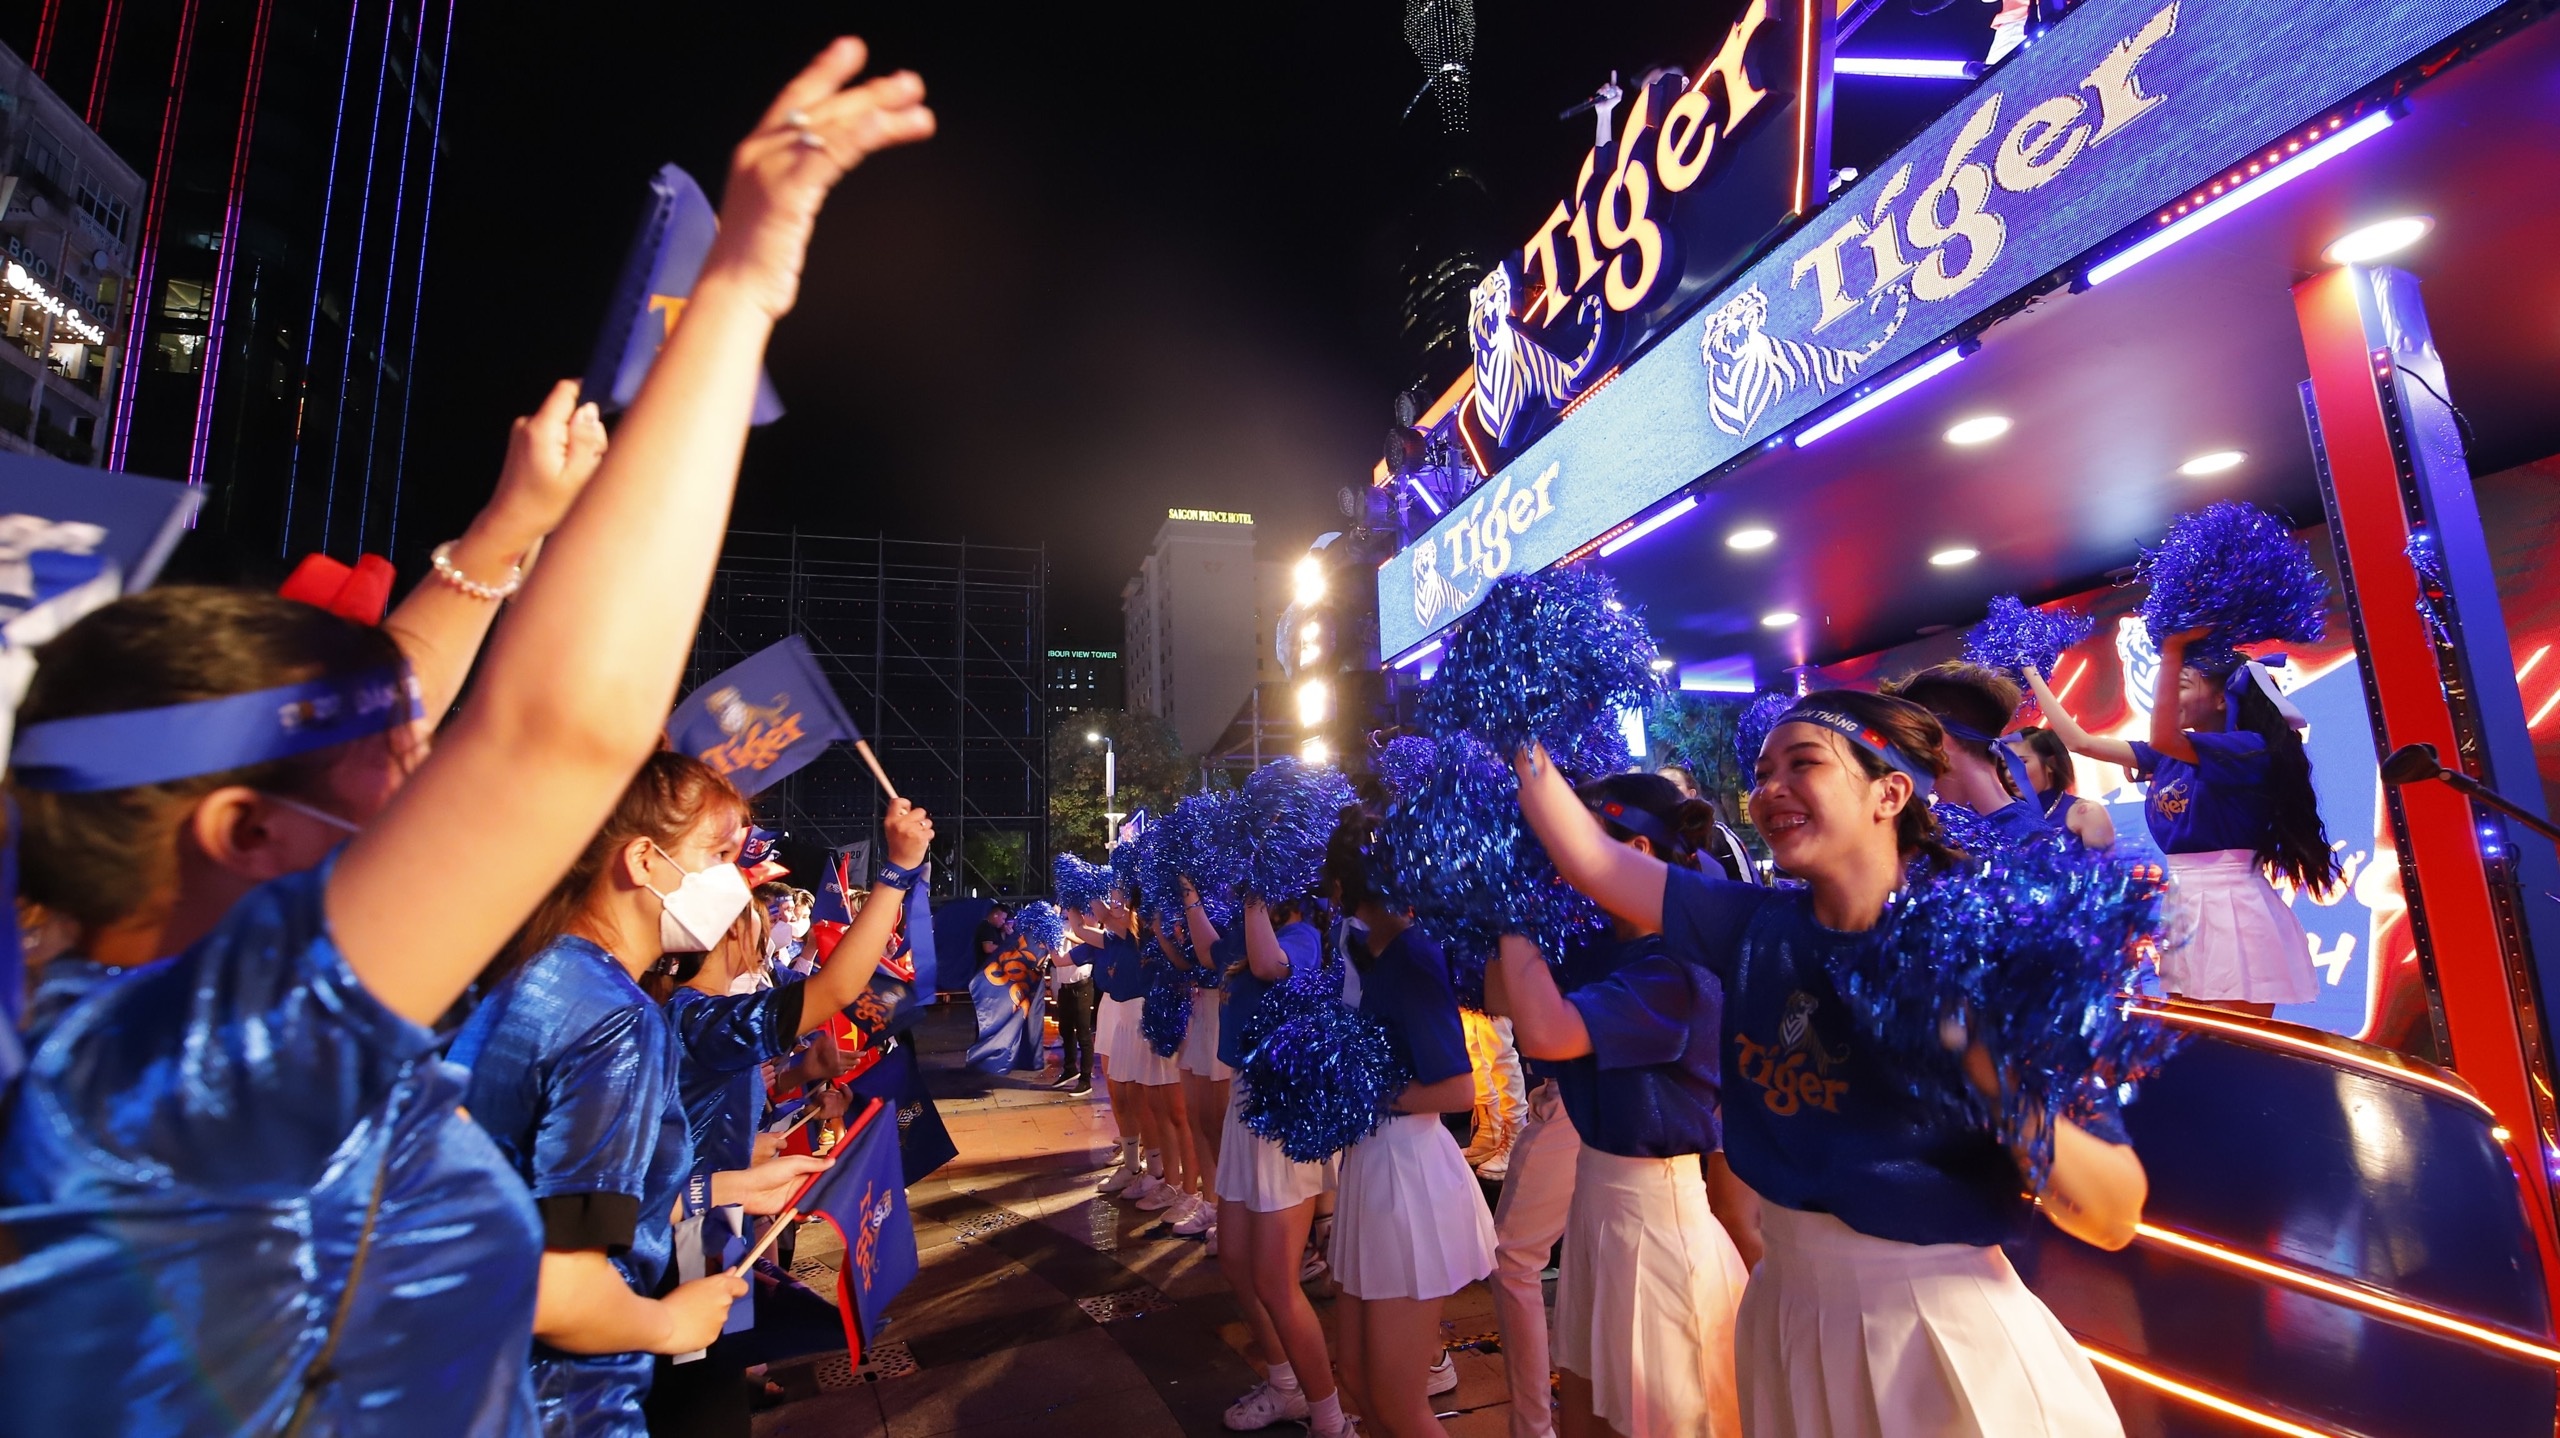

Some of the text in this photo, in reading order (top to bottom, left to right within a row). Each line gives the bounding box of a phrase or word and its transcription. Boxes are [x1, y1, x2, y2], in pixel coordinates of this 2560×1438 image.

[1524, 0, 1767, 329] Tiger
[1790, 0, 2181, 335] Tiger
[1168, 508, 1254, 524] SAIGON PRINCE HOTEL
[1443, 460, 1560, 579] Tiger
[1071, 650, 1090, 658] VIEW
[1091, 651, 1117, 659] TOWER
[840, 850, 861, 860] 220
[1734, 1032, 1850, 1117] Tiger
